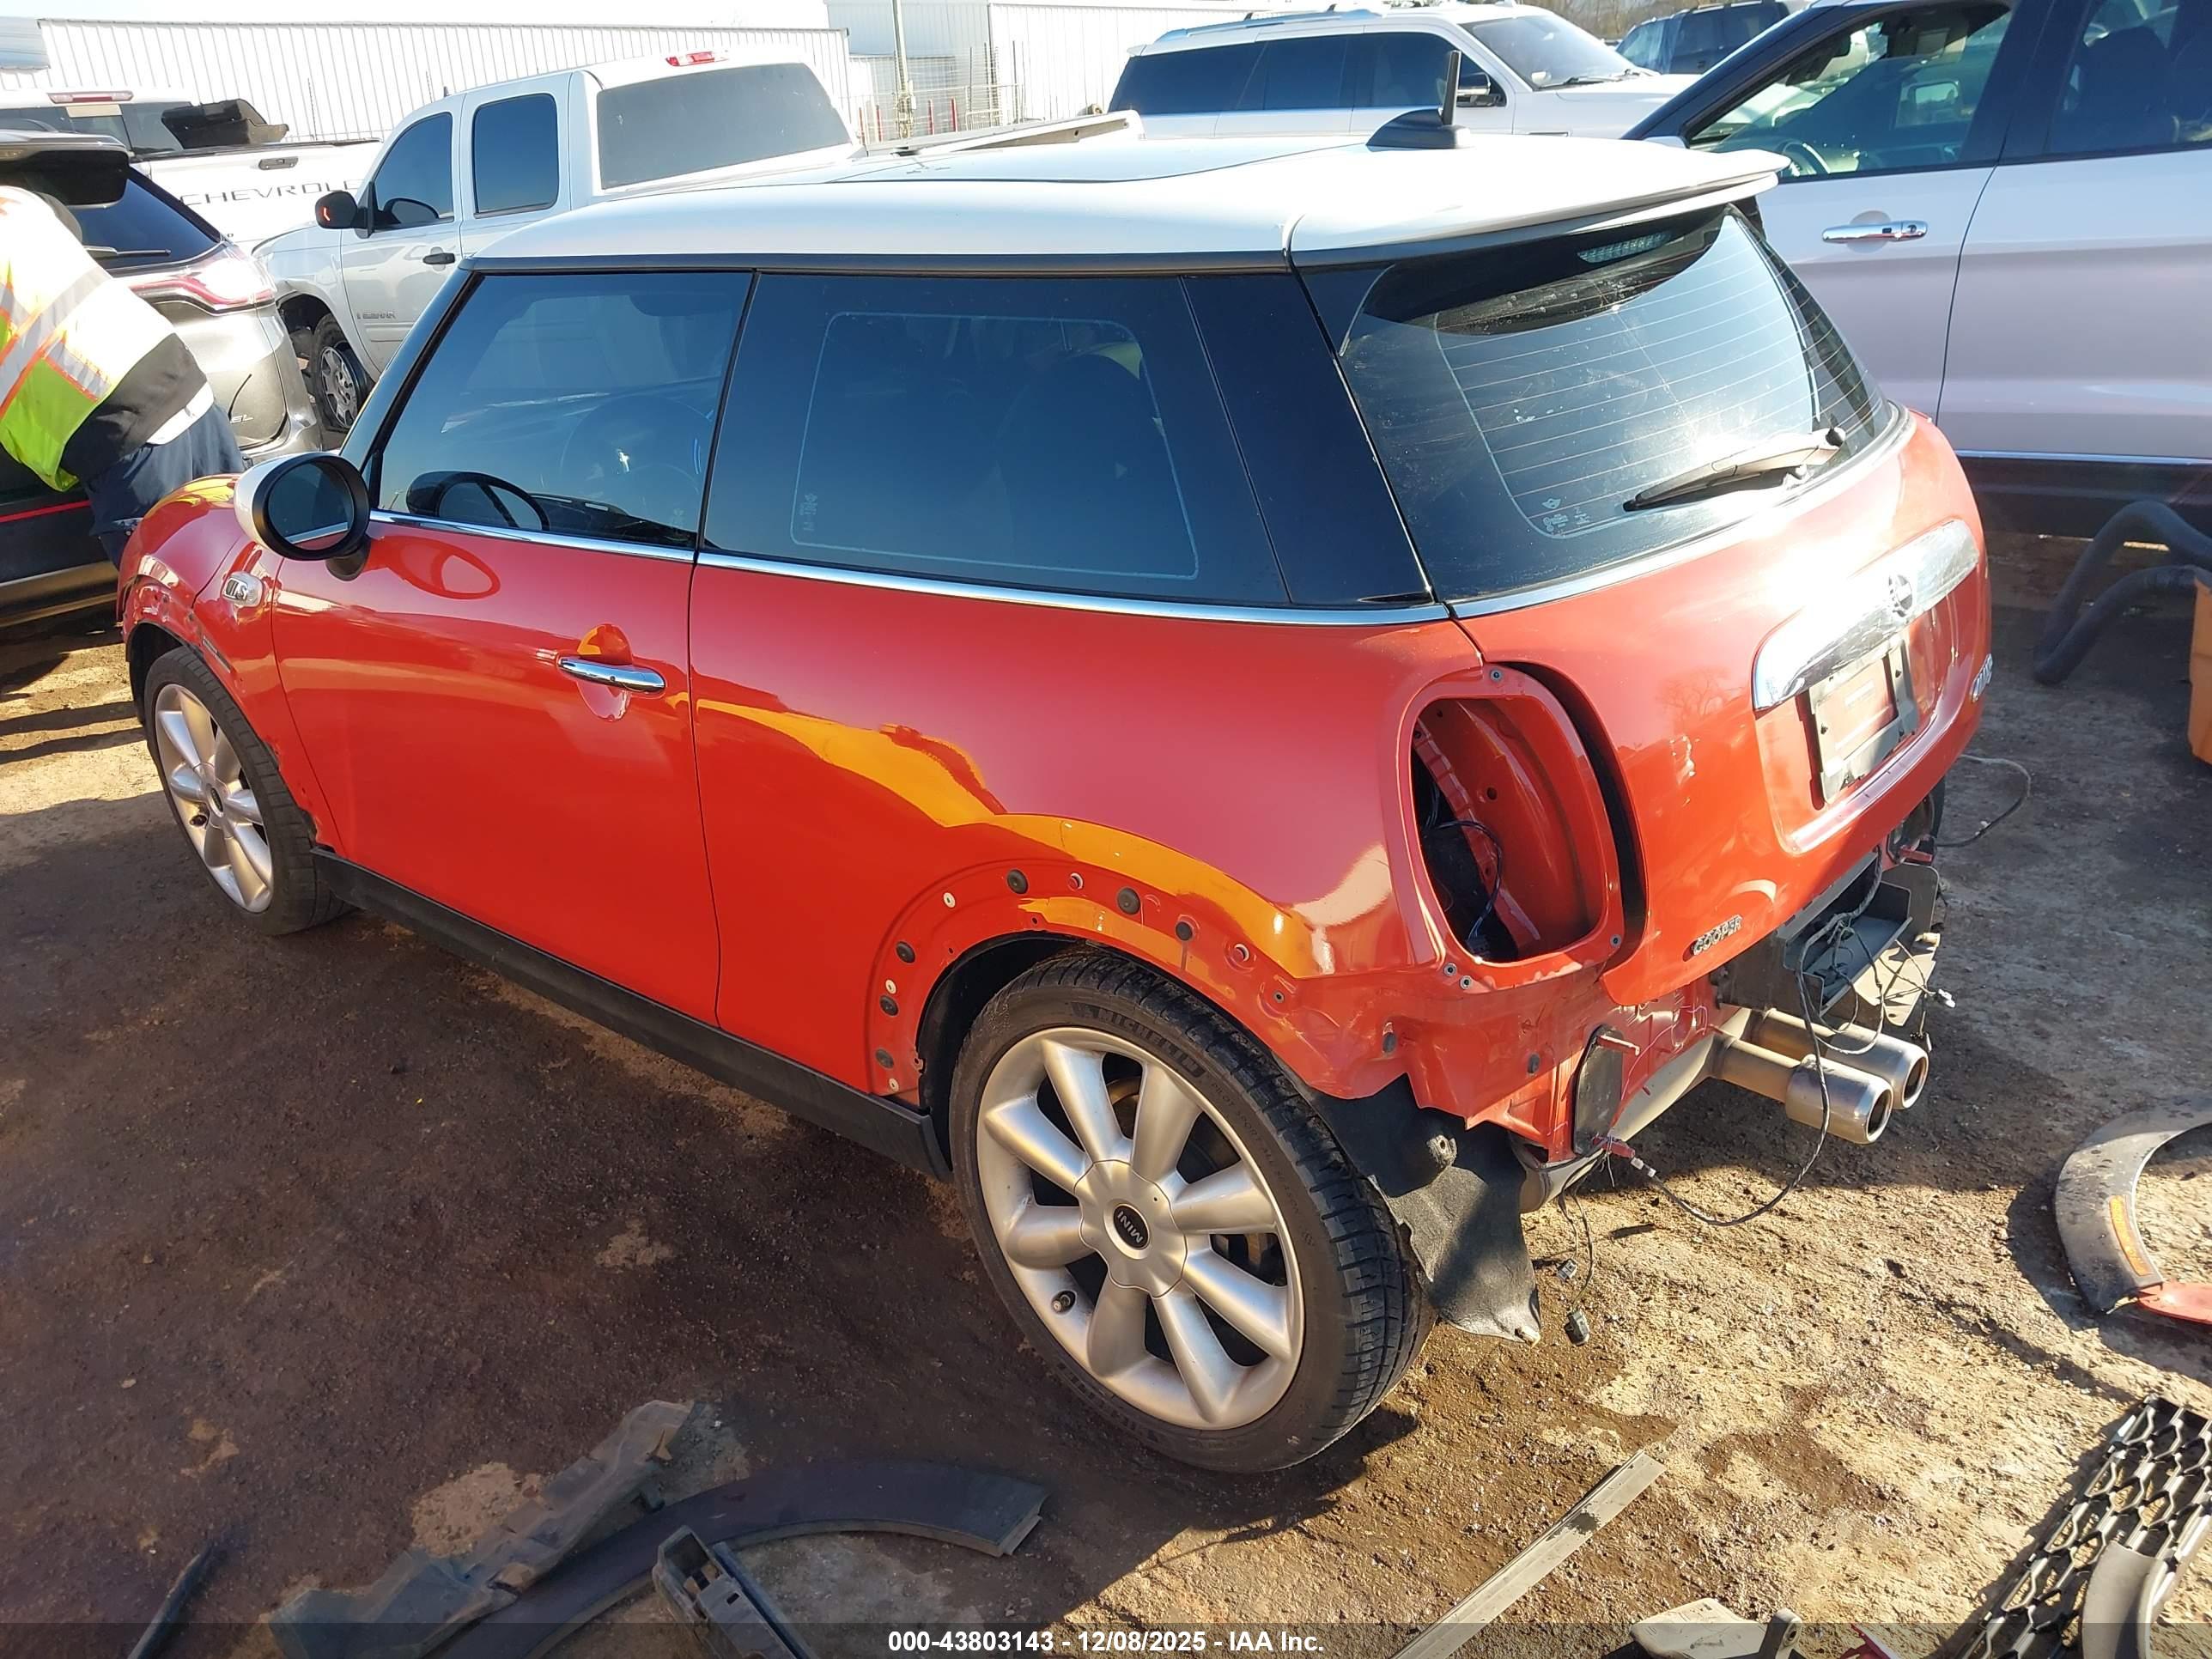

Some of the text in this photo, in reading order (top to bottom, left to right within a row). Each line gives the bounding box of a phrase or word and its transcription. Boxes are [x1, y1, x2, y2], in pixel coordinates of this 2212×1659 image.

[179, 178, 364, 205] CHEVROLE
[230, 414, 254, 423] EL
[1692, 915, 1742, 956] COOPER
[1099, 1006, 1206, 1078] MICHELIN
[1117, 1210, 1144, 1243] MINI
